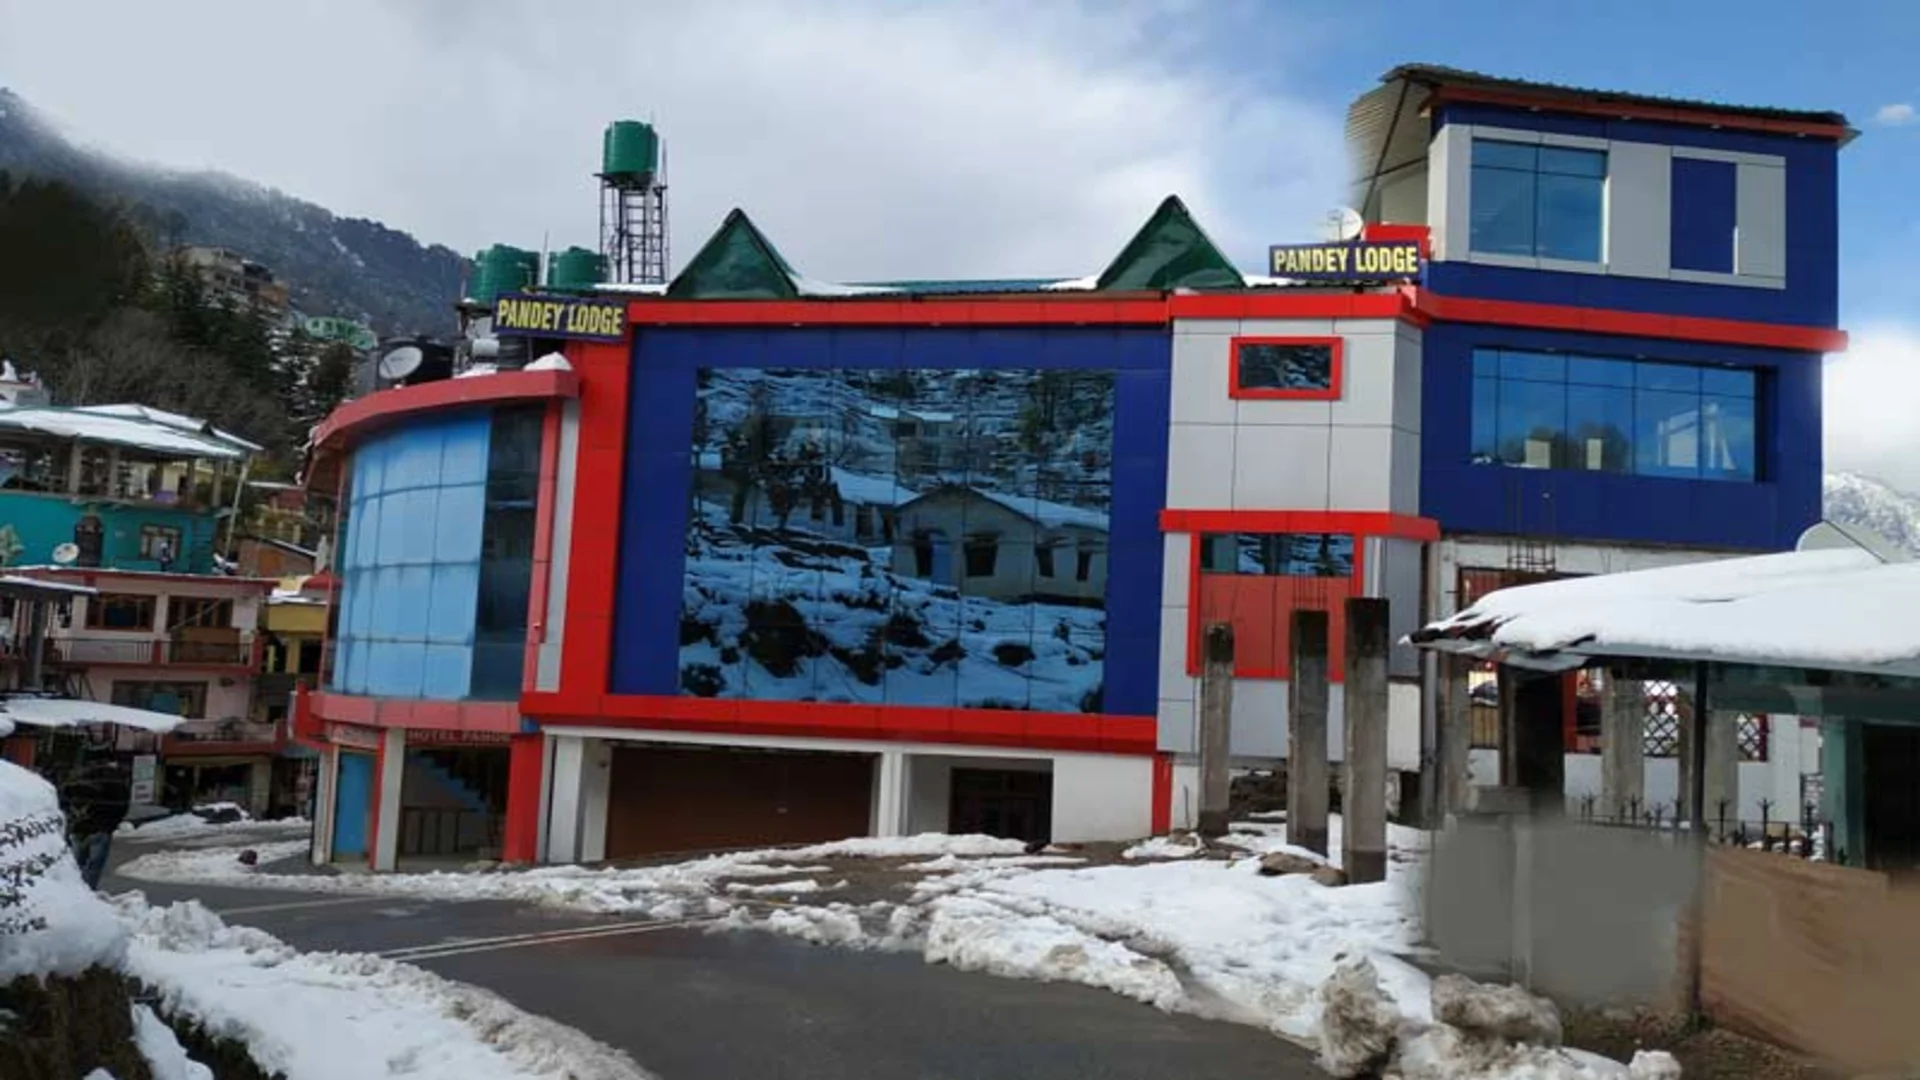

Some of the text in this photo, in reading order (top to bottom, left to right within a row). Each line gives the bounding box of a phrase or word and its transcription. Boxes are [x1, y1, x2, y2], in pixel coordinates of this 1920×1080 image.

[1273, 247, 1418, 273] PANDEY LODGE
[496, 299, 624, 336] PANDEY LODGE
